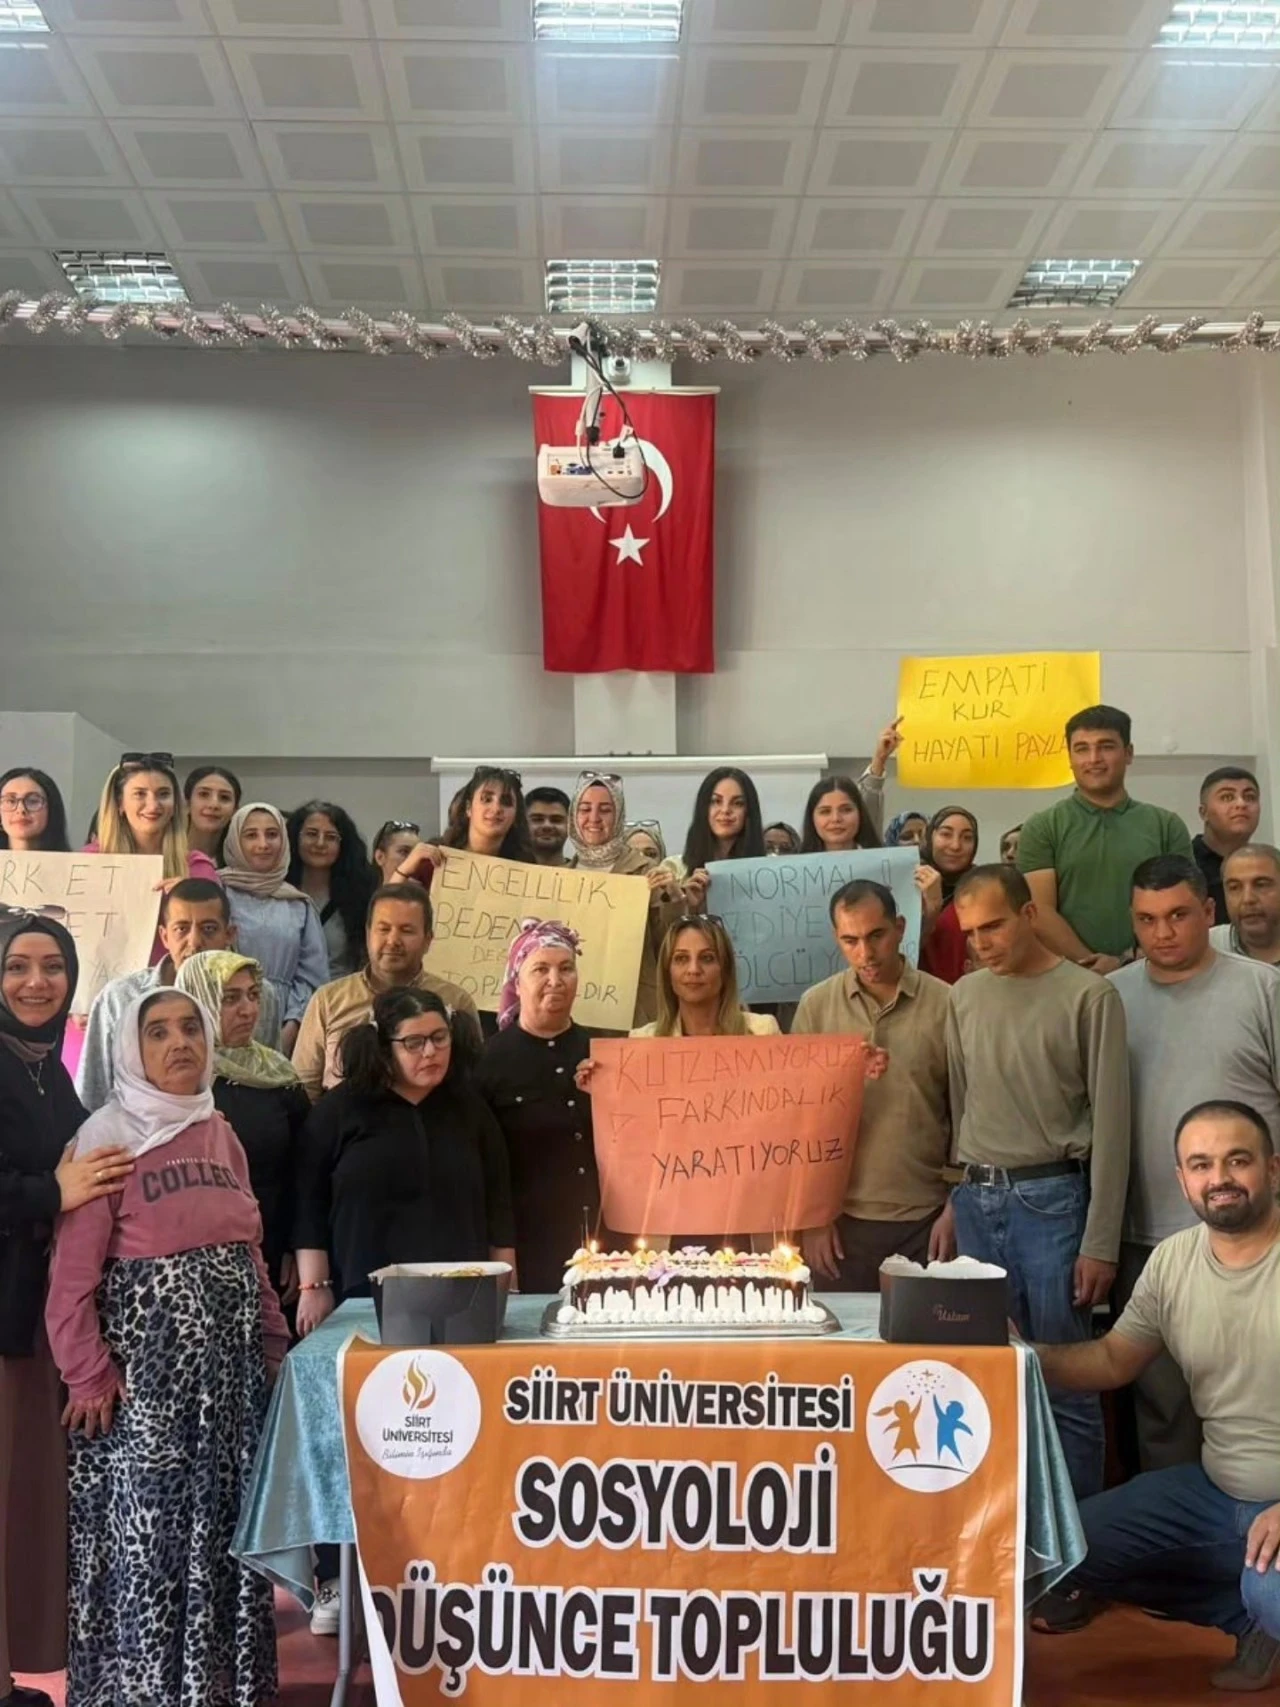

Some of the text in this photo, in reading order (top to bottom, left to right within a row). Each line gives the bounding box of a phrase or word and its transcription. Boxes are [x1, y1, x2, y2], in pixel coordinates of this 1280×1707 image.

[919, 662, 1048, 699] EMPATİ
[952, 700, 1011, 721] KUR
[913, 735, 999, 763] HAYATI
[66, 864, 123, 896] ET
[441, 856, 616, 910] ENGELLİLİK
[657, 1083, 848, 1129] FARKINDALIK
[651, 1137, 844, 1189] YARATIYORUZ
[506, 1368, 853, 1430] SİİRT ÜNİVERSİTESİ
[381, 1427, 454, 1444] ÜNİVERSİTESİ
[404, 1413, 431, 1428] SİİRT
[518, 1446, 833, 1549] SOSYOLOJİ
[371, 1565, 989, 1692] DÜŞÜNCE TOPLULUĞU
